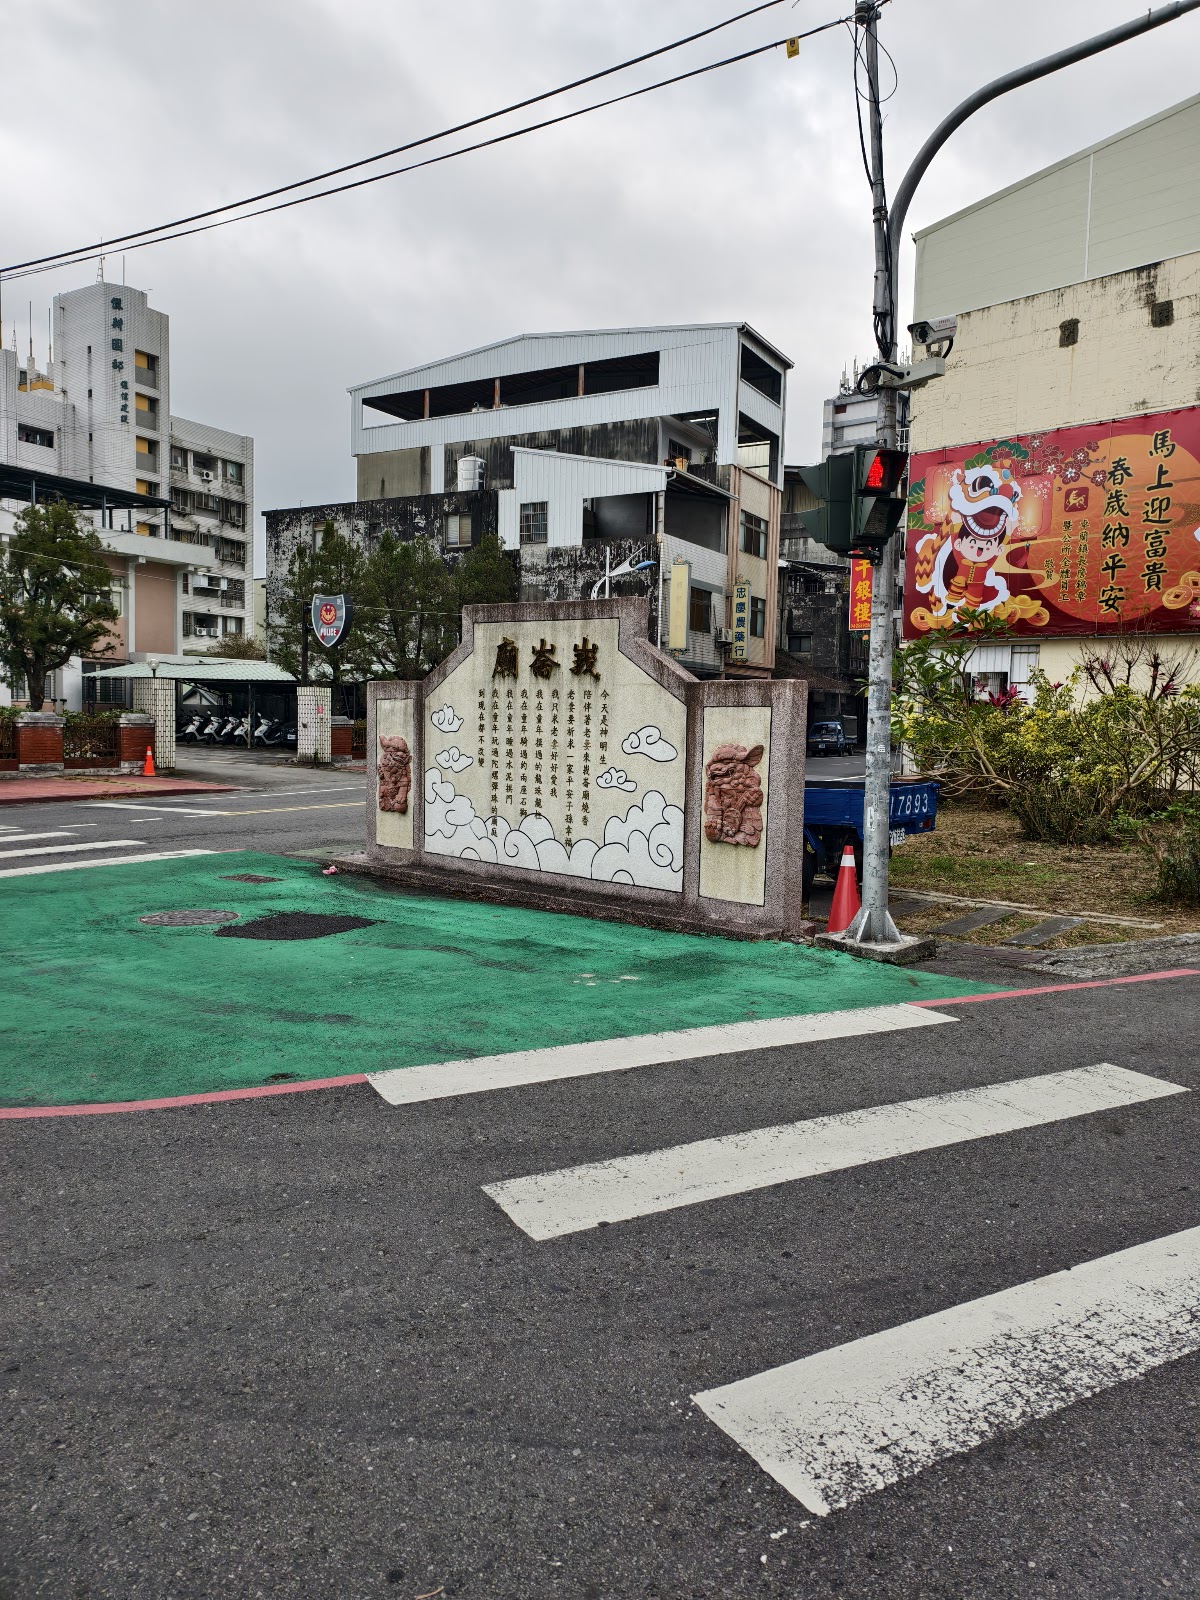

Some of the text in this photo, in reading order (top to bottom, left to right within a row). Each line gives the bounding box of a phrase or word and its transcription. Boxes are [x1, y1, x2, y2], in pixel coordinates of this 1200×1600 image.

[1098, 457, 1133, 613] 春歲納平安
[1141, 431, 1175, 592] 馬上迎富貴
[1044, 559, 1054, 580] 敬賀
[320, 628, 337, 636] POLICE
[734, 587, 746, 657] 忠慶農藥行
[477, 687, 486, 768] 到現在都不改變
[550, 688, 560, 798] 我只求老妻好好愛我
[599, 689, 610, 765] 今天是神明生
